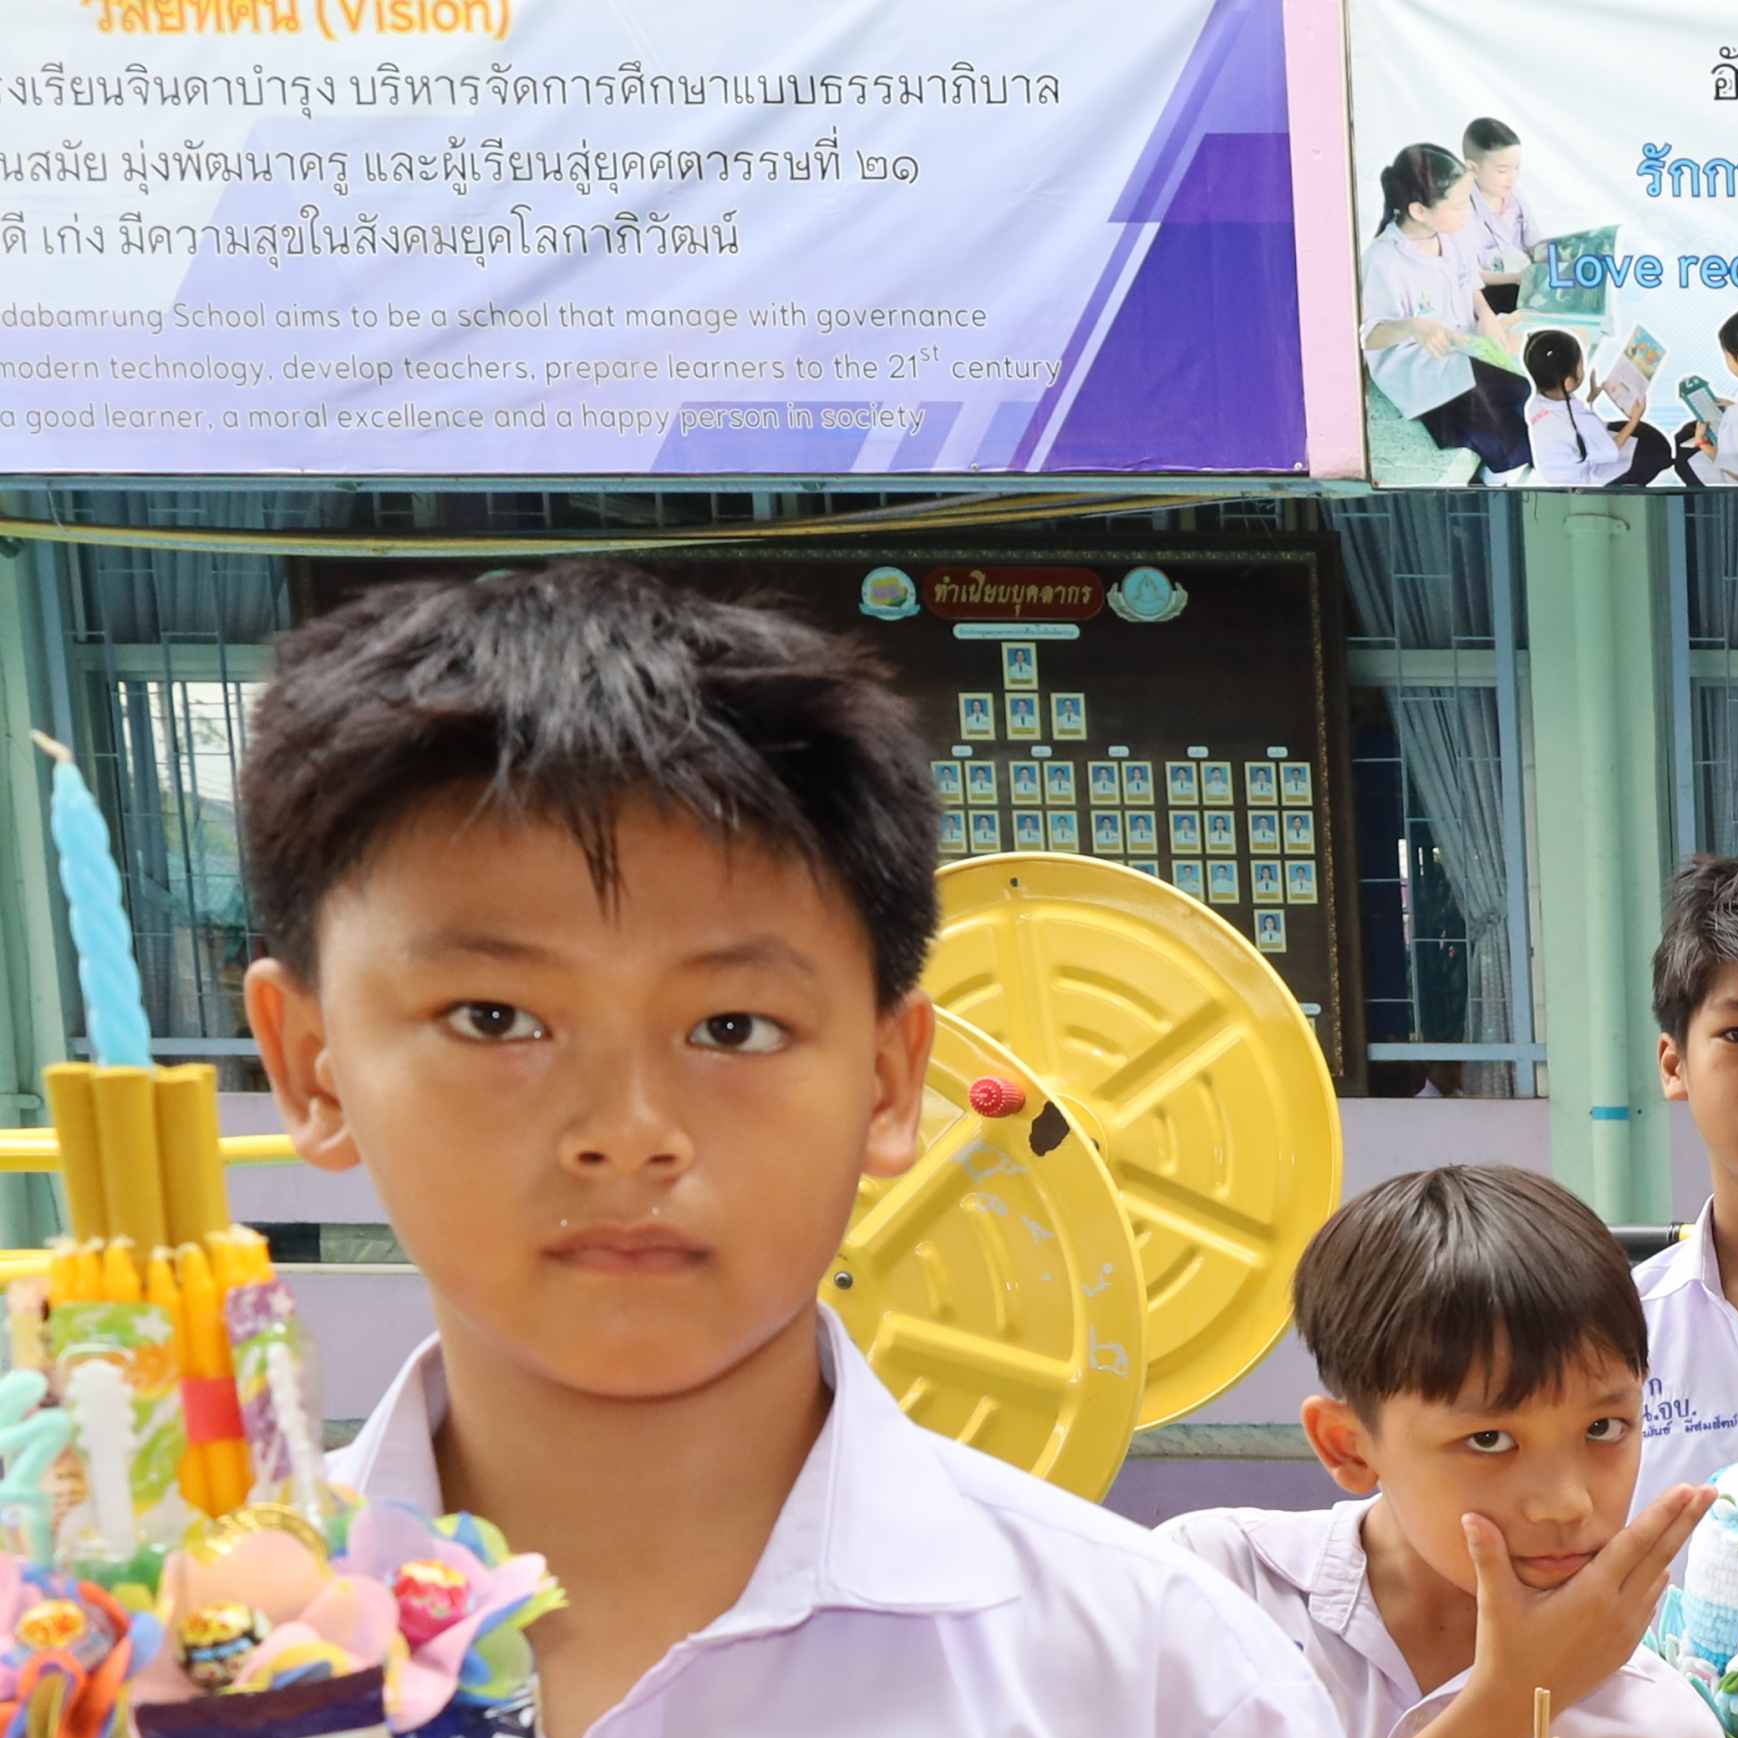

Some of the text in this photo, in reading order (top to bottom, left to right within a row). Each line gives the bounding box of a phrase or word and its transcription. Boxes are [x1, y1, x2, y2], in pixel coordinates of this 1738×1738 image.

[0, 62, 336, 118] งเรียนจินดาบำรุง
[857, 151, 920, 182] ๒๑
[43, 212, 104, 255] เก่ง
[1546, 243, 1664, 290] Love
[4, 302, 987, 334] dabamrung School aims to be a school that manage with governance
[110, 354, 273, 386] technology,
[283, 354, 393, 386] develop
[404, 354, 535, 383] teachers,
[545, 358, 658, 386] prepare
[668, 354, 785, 379] learners
[797, 357, 823, 379] to
[834, 354, 878, 379] the
[952, 357, 1062, 386] century
[26, 404, 95, 434] good
[104, 404, 213, 431] learner,
[223, 409, 238, 428] a
[249, 404, 327, 428] moral
[337, 404, 484, 428] excellence
[494, 404, 545, 428] and
[557, 409, 572, 428] a
[582, 404, 670, 434] happy
[681, 408, 779, 434] person
[788, 404, 813, 428] in
[822, 404, 926, 435] society
[1648, 1377, 1662, 1396] ก
